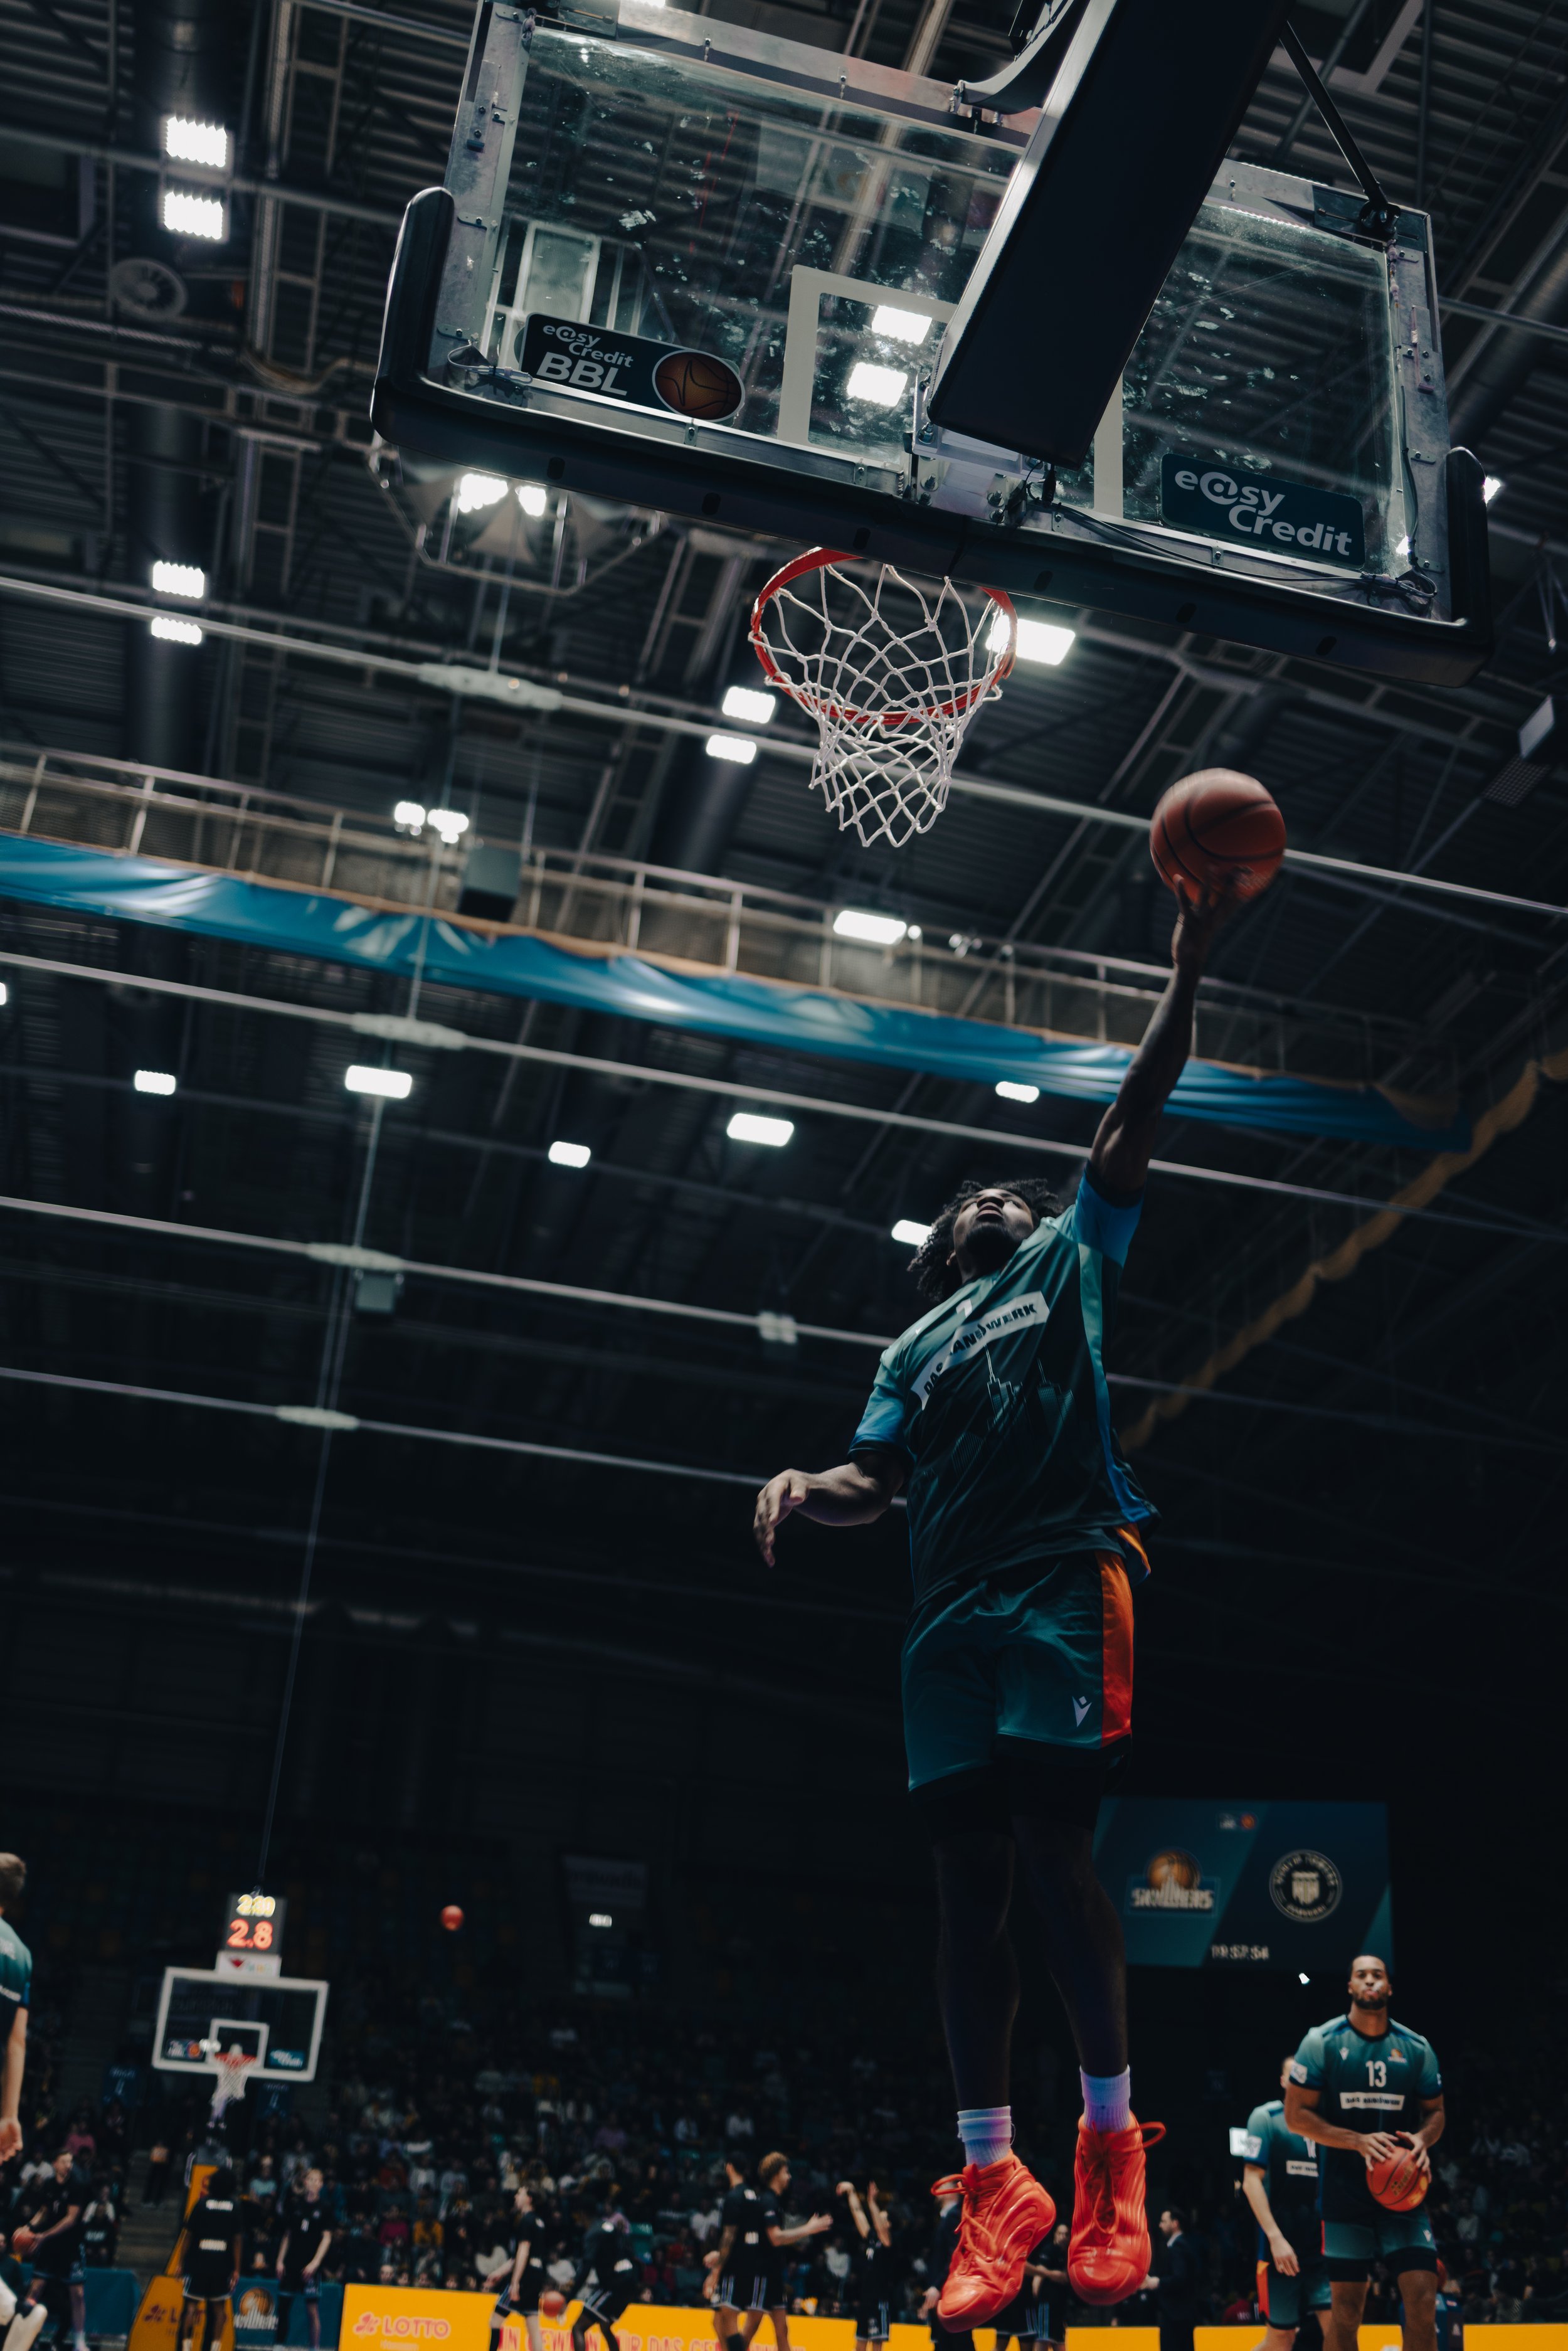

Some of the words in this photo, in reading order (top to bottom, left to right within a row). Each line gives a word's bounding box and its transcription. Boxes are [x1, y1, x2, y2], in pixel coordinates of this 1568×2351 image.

[569, 342, 633, 368] Credit
[536, 352, 627, 396] BBL
[1229, 504, 1352, 556] Credit
[227, 1918, 273, 1950] 2.8
[1365, 2061, 1387, 2088] 13
[382, 2316, 451, 2339] LOTTO
